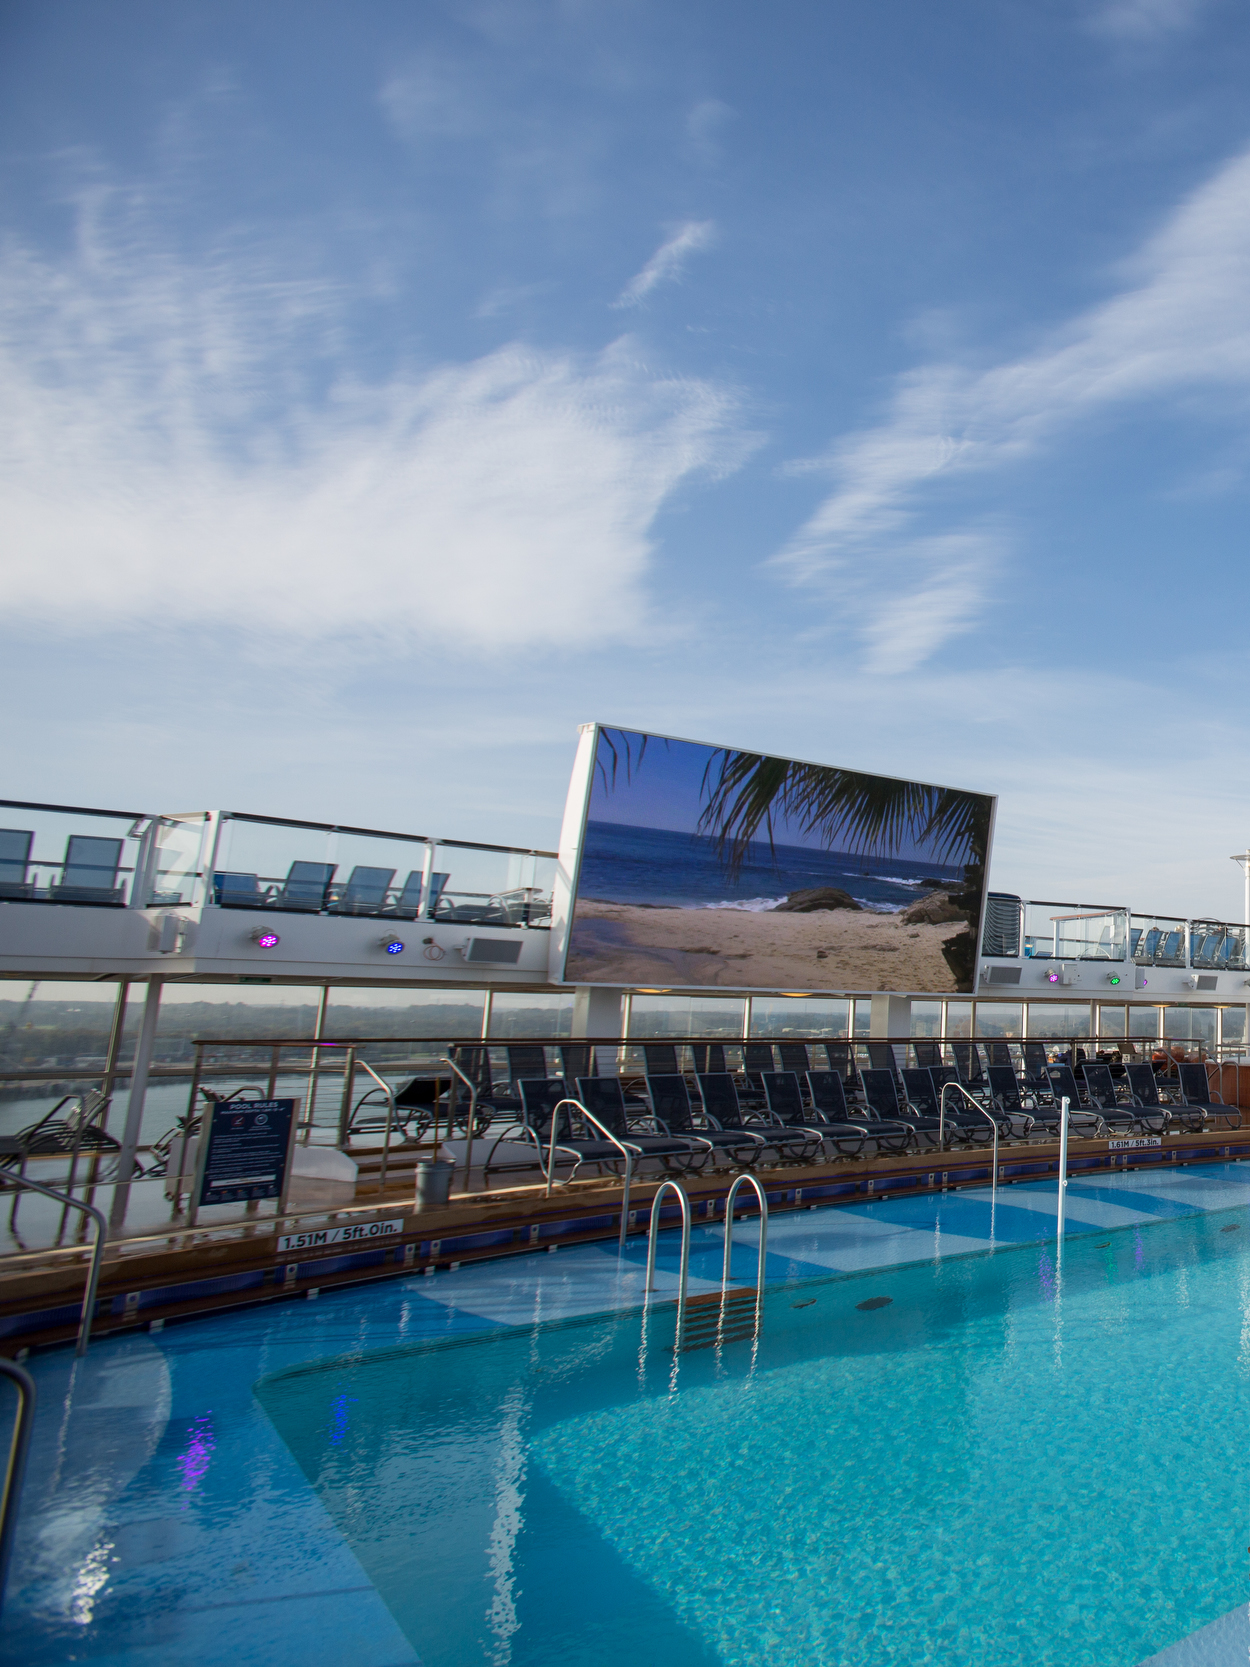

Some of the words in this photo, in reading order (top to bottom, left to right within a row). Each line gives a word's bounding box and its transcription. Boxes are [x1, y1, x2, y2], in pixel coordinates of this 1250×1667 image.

[252, 1101, 279, 1109] RULES
[1111, 1140, 1129, 1149] 1.61M
[1135, 1138, 1159, 1147] 5ft.3in.
[284, 1231, 328, 1250] 1.51M
[331, 1229, 340, 1242] /
